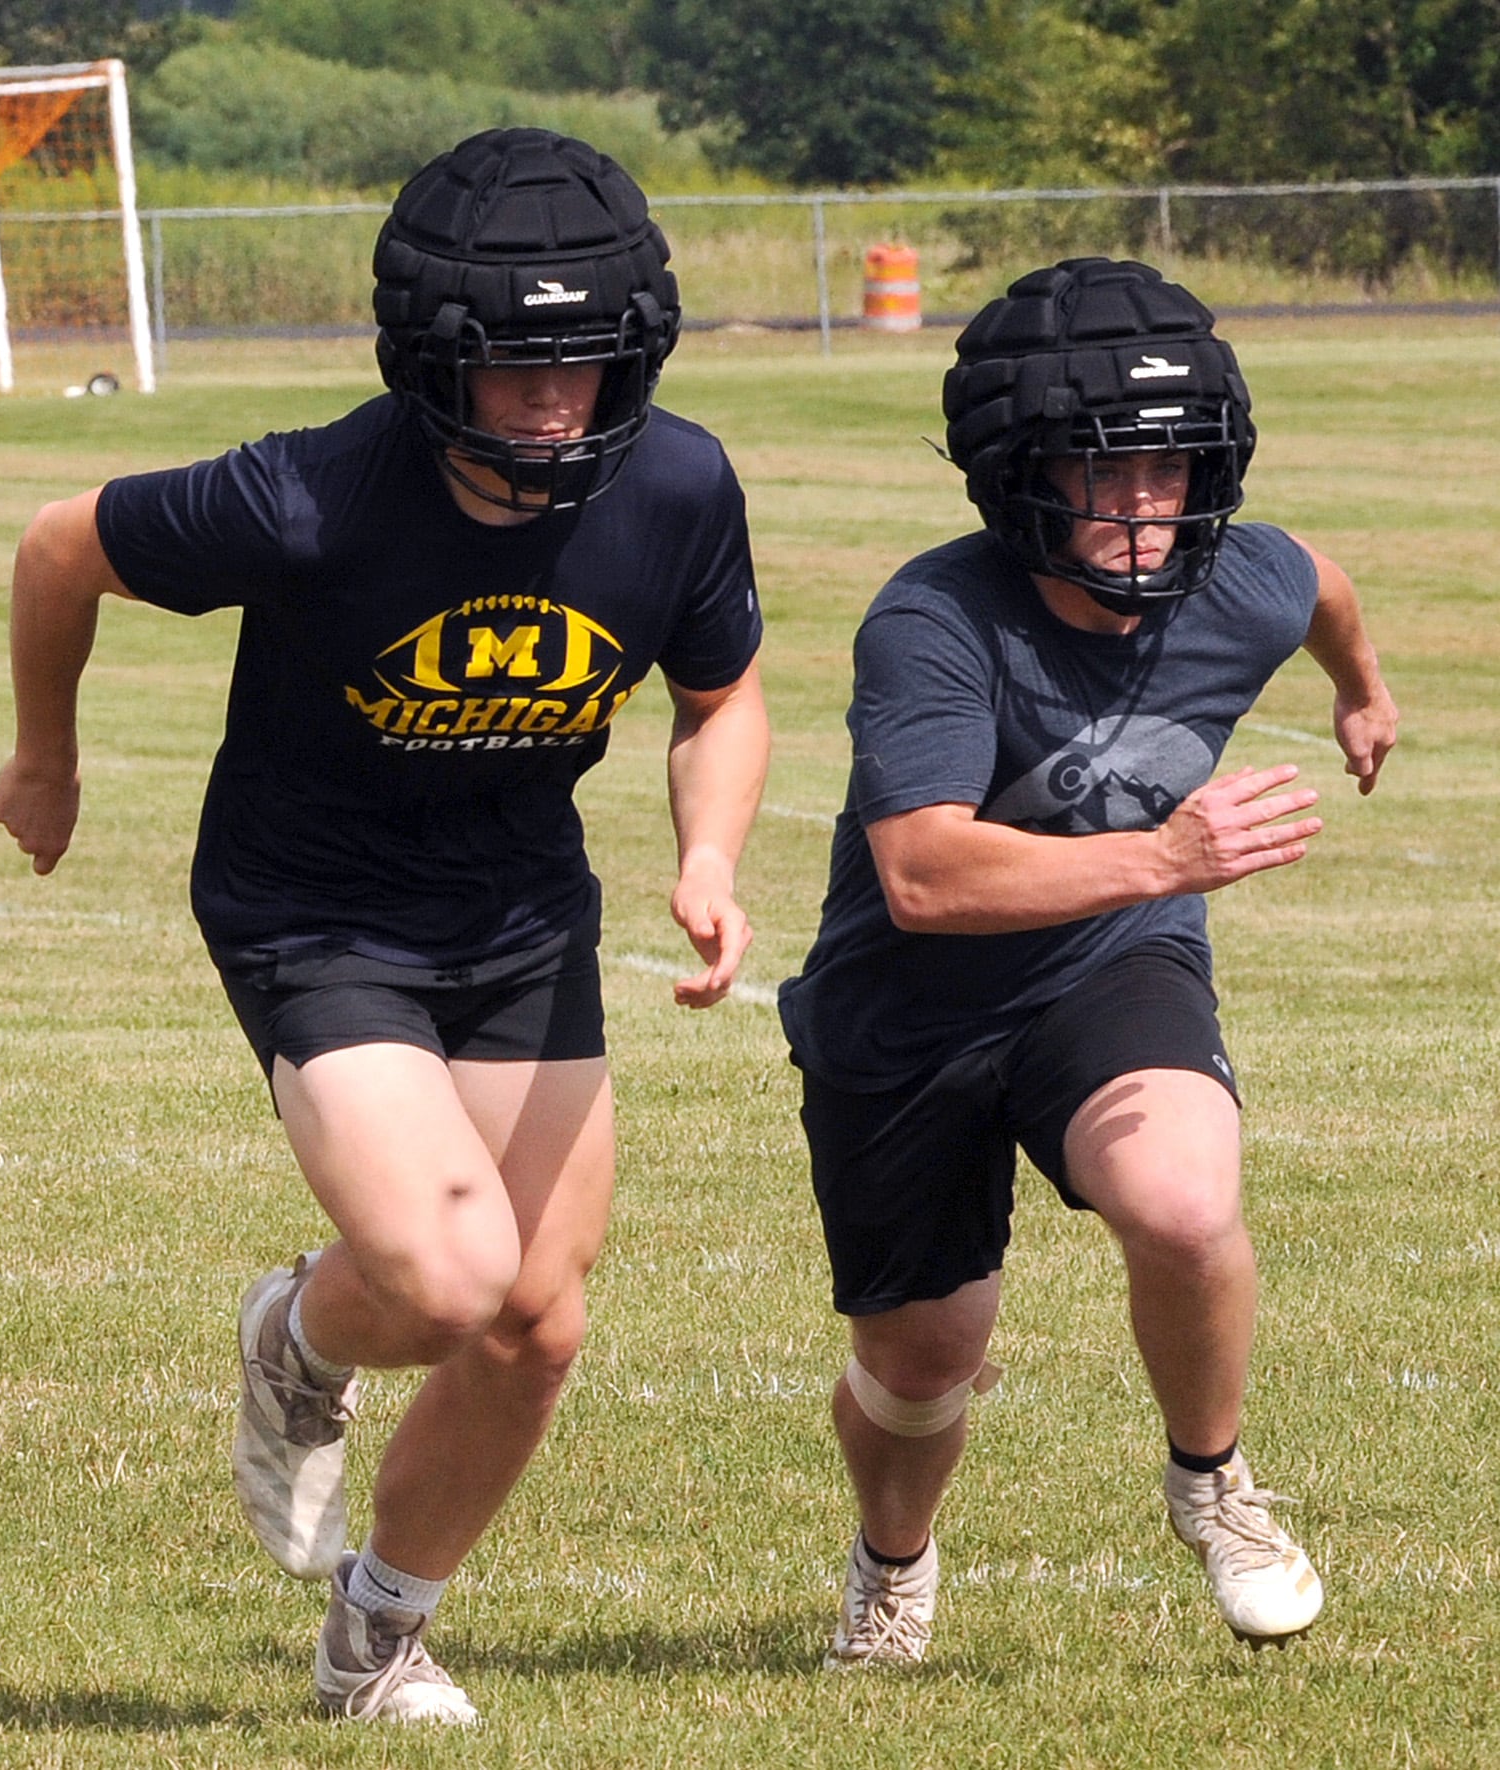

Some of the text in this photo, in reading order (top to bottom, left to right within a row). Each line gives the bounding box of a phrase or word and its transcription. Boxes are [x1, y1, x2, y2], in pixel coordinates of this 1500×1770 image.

[523, 290, 589, 306] GUARDIAN
[465, 625, 541, 678] M
[380, 735, 585, 751] FOOTBALL
